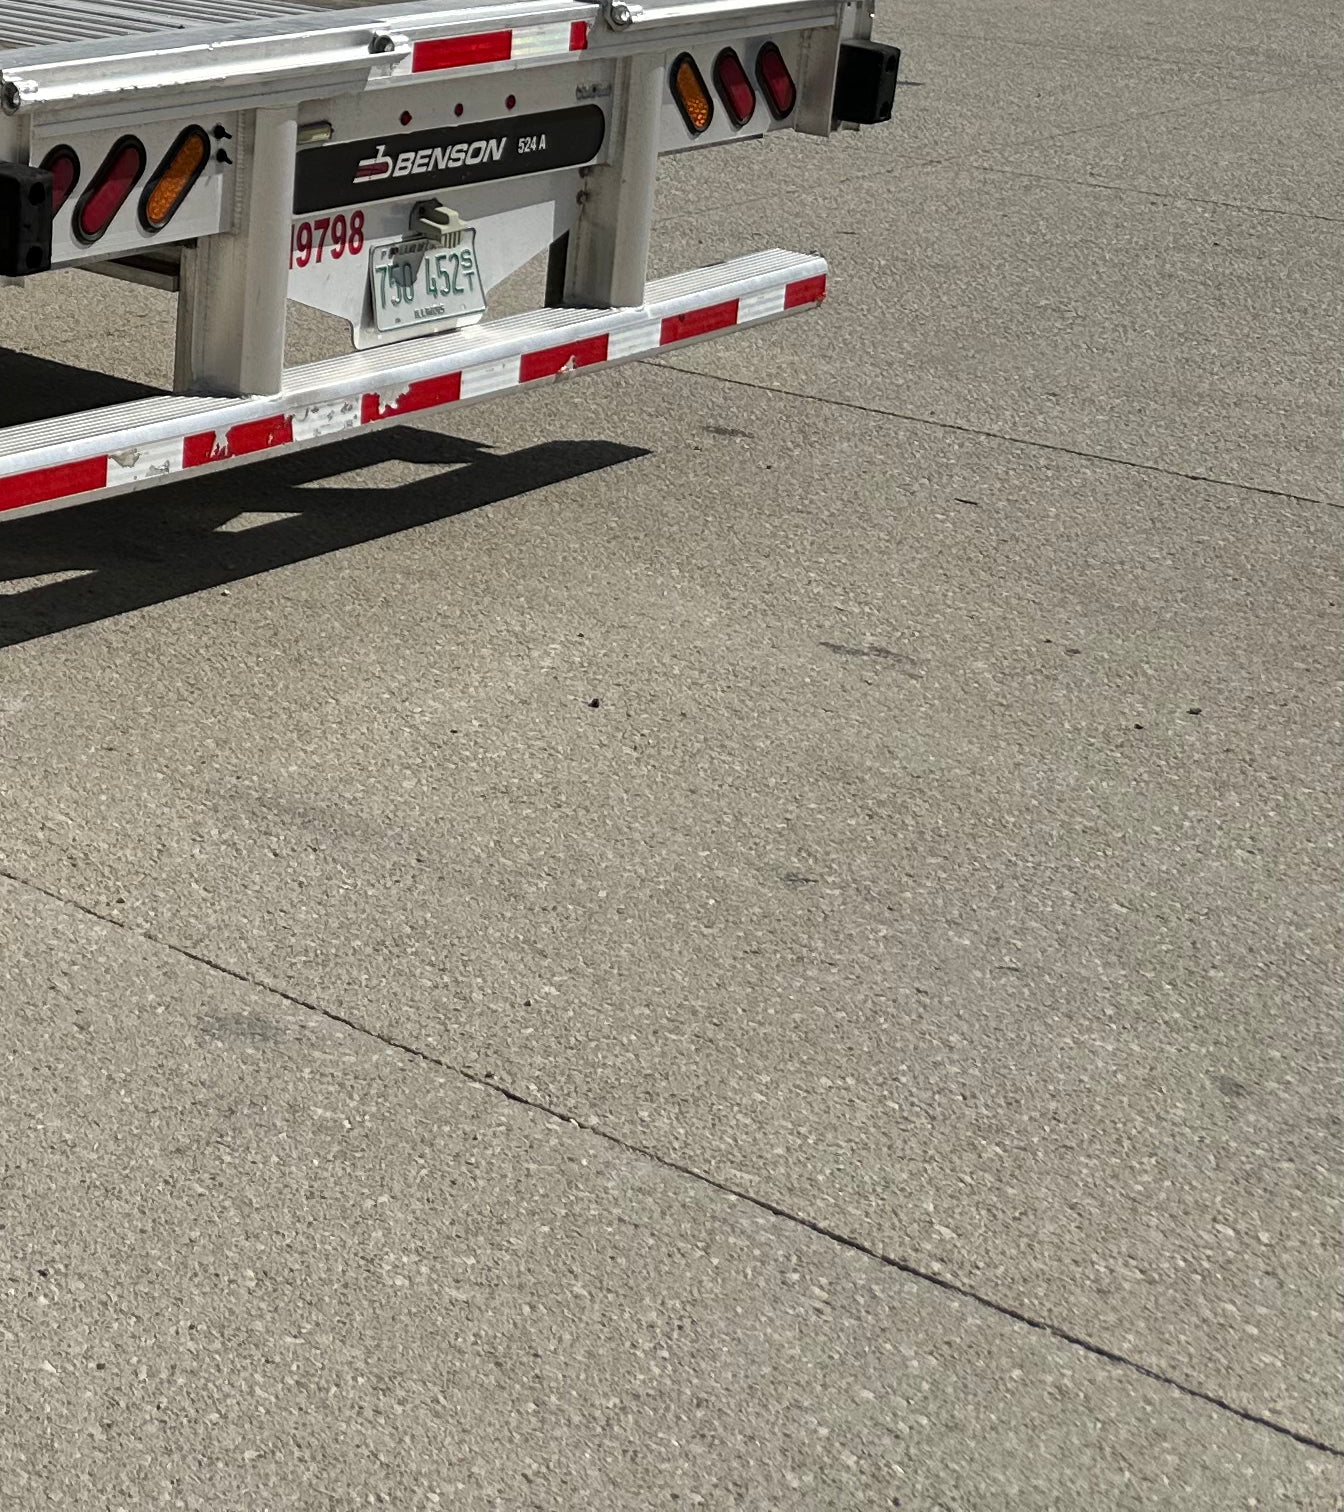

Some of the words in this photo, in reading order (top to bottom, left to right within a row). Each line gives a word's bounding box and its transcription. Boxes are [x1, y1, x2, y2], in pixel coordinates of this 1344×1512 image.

[392, 137, 507, 178] BENSON
[517, 136, 537, 154] 524
[538, 134, 546, 150] A
[289, 210, 365, 270] 9798
[375, 262, 415, 309] 750
[424, 252, 465, 299] 452
